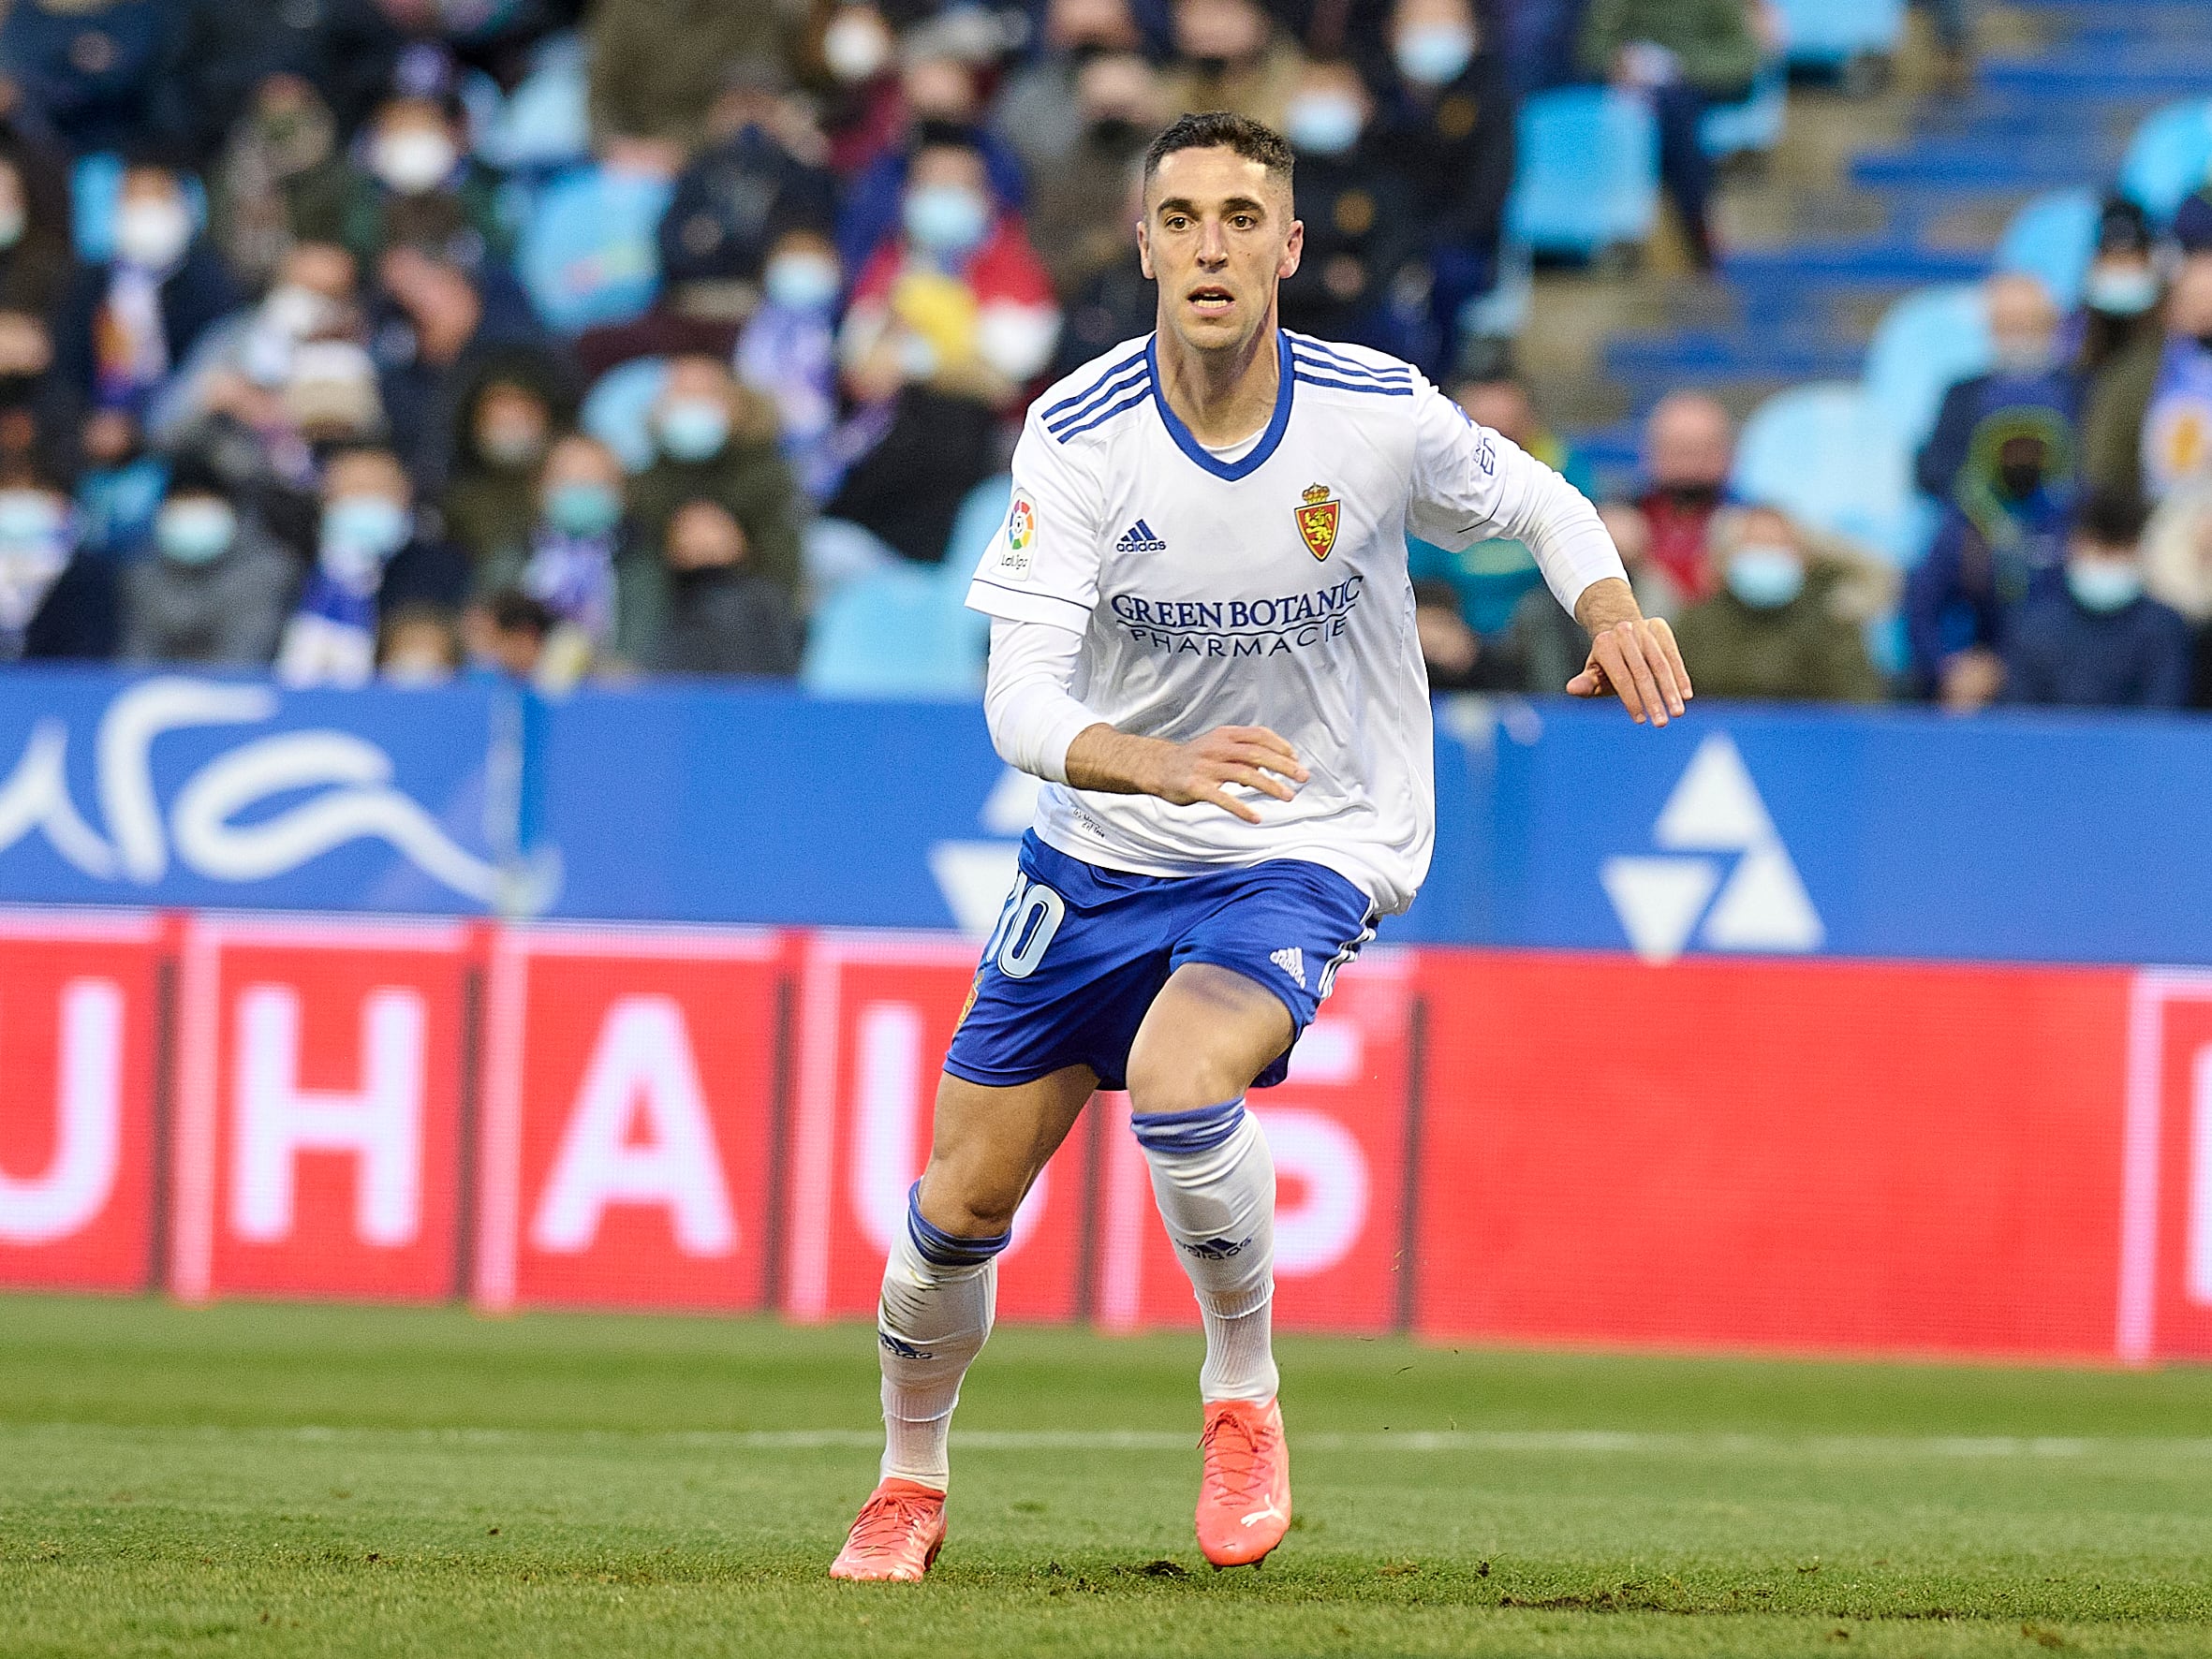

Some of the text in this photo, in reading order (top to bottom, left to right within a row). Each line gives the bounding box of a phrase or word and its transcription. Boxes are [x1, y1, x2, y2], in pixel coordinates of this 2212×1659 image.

[1116, 539, 1167, 552] adidas
[1111, 575, 1364, 629] GREEN BOTANIC
[1130, 615, 1348, 657] PHARMACIE
